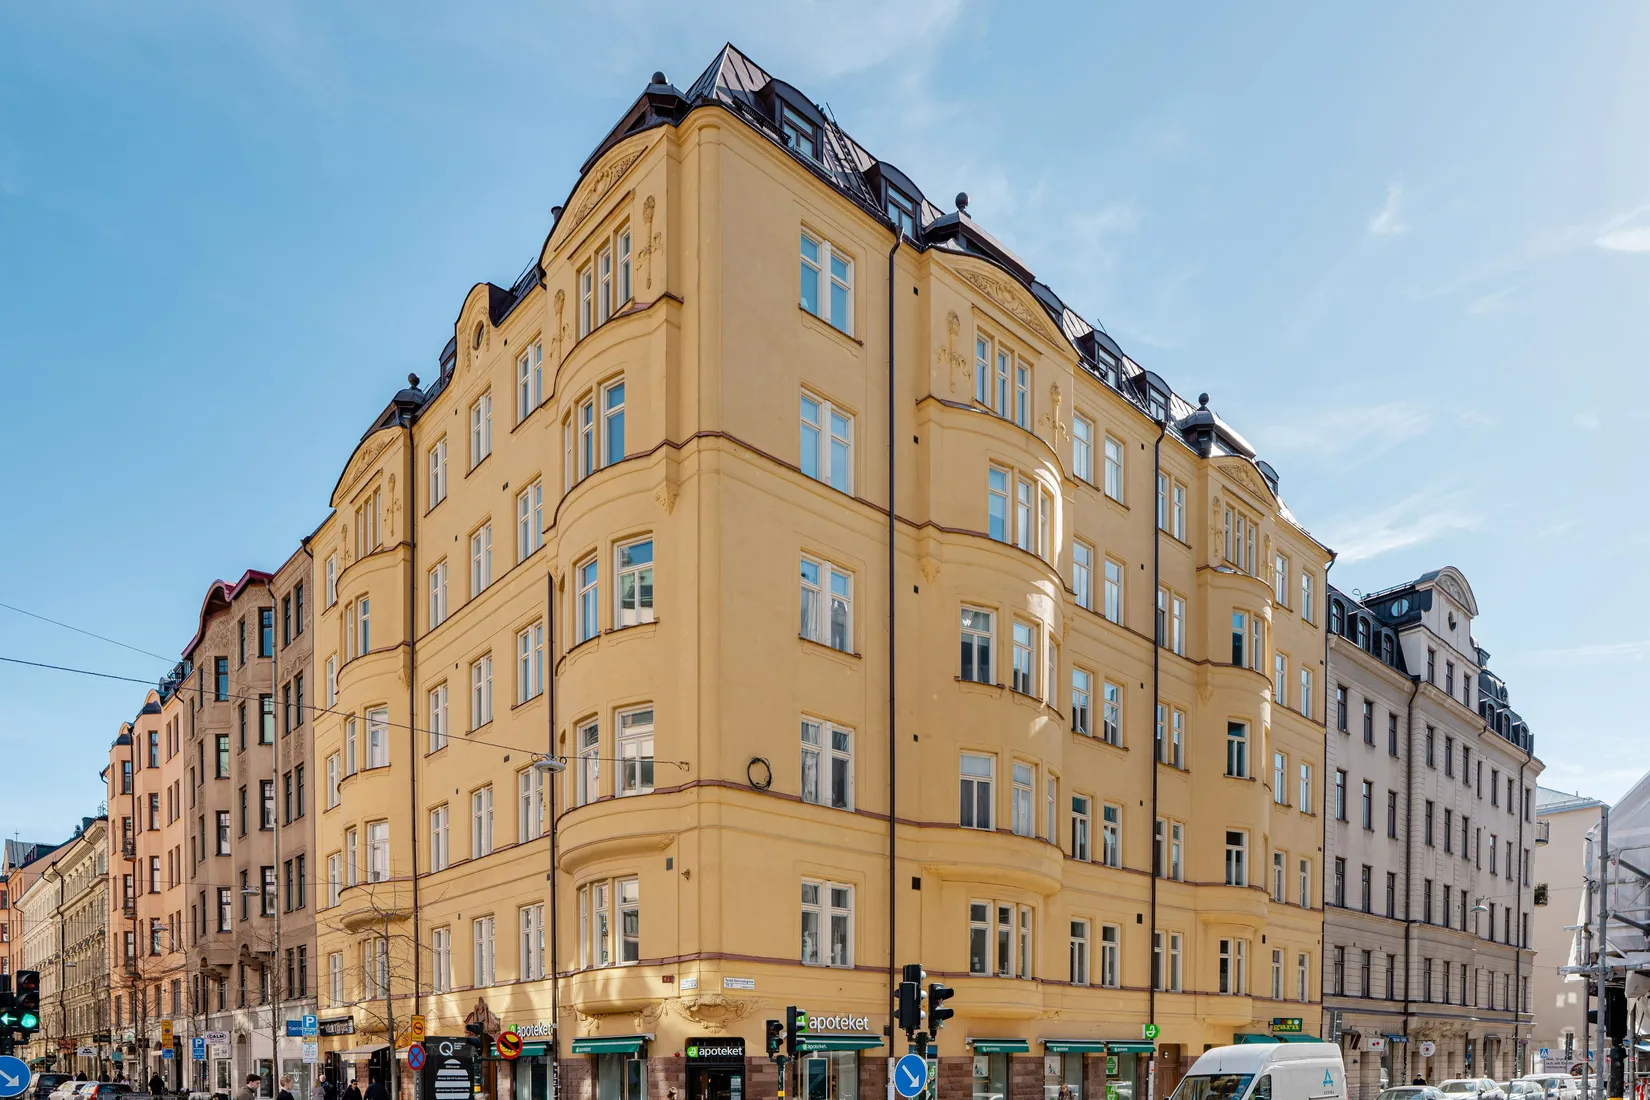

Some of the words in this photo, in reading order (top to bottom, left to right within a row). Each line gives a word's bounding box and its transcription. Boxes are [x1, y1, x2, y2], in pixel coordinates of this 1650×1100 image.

[306, 1016, 315, 1027] P
[809, 1014, 870, 1032] apoteket
[517, 1021, 553, 1040] apoteket
[195, 1039, 203, 1047] P
[439, 1041, 453, 1056] Q
[699, 1047, 743, 1057] apoteket
